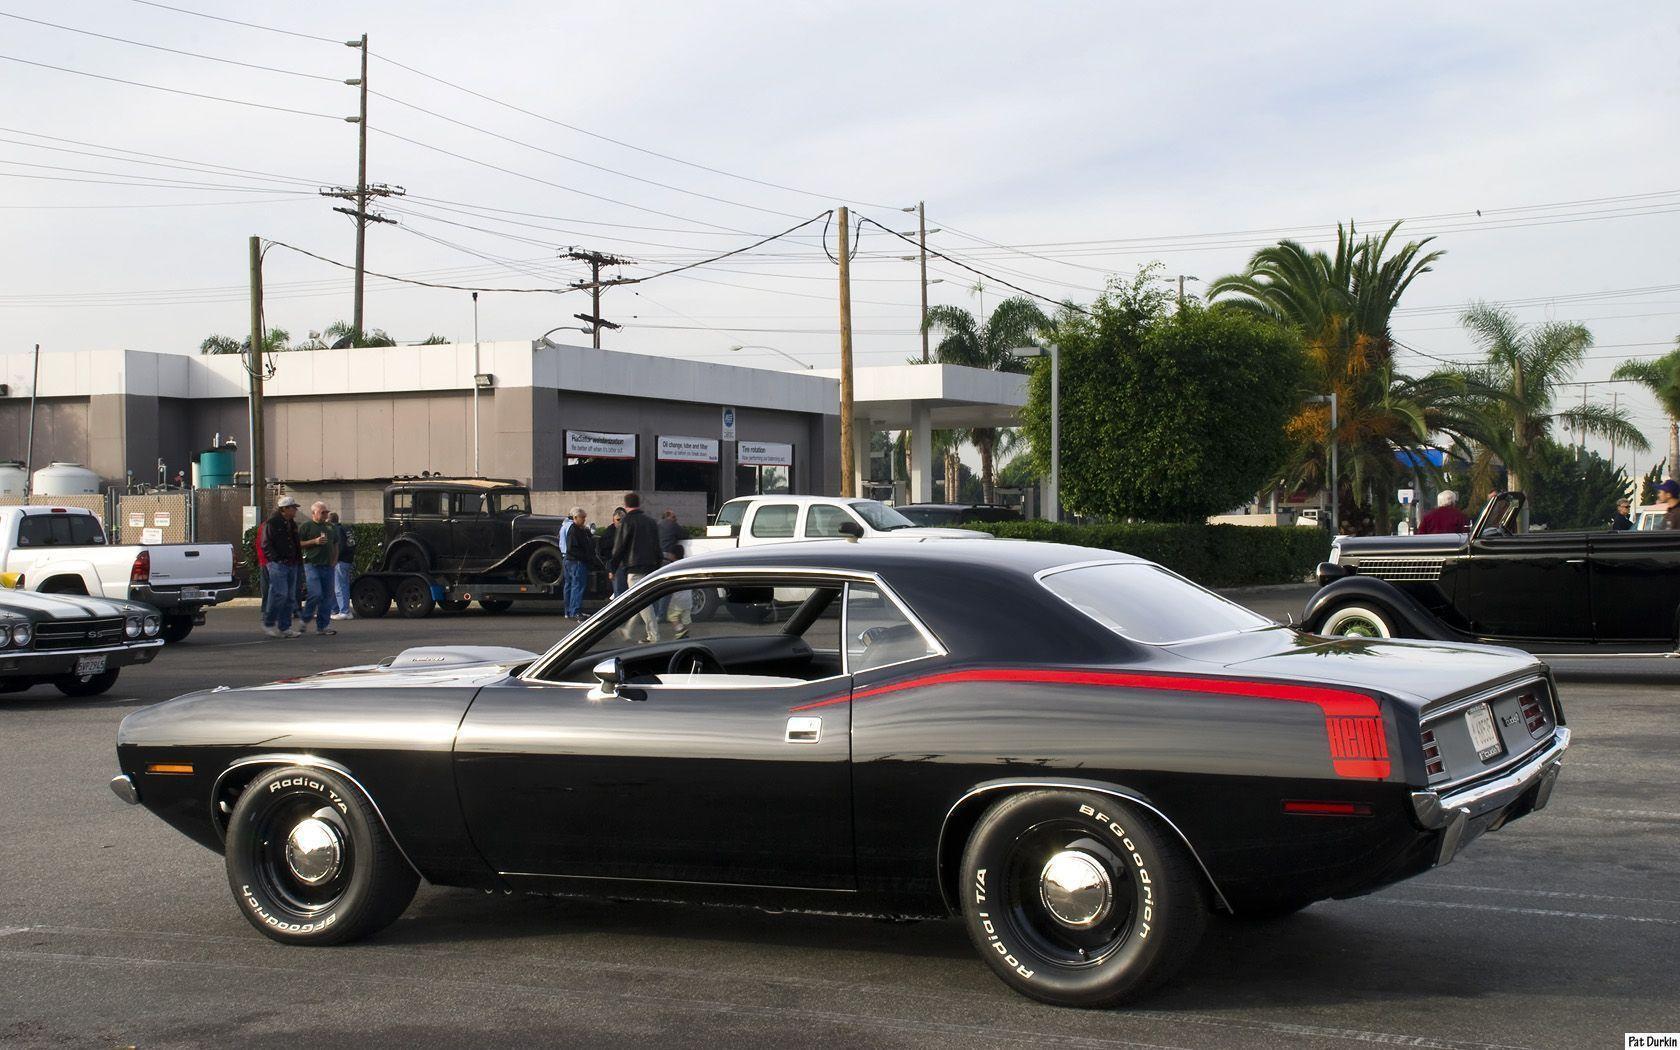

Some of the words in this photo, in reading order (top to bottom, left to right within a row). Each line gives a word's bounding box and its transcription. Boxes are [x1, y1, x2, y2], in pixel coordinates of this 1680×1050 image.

[742, 445, 750, 453] Tire
[751, 446, 766, 454] rotation
[269, 777, 324, 793] Radial
[329, 790, 348, 814] T/A
[976, 869, 987, 904] T/A
[1079, 804, 1154, 939] BFGoodrich
[243, 885, 337, 933] BFGoodrich
[979, 912, 1035, 979] Radial
